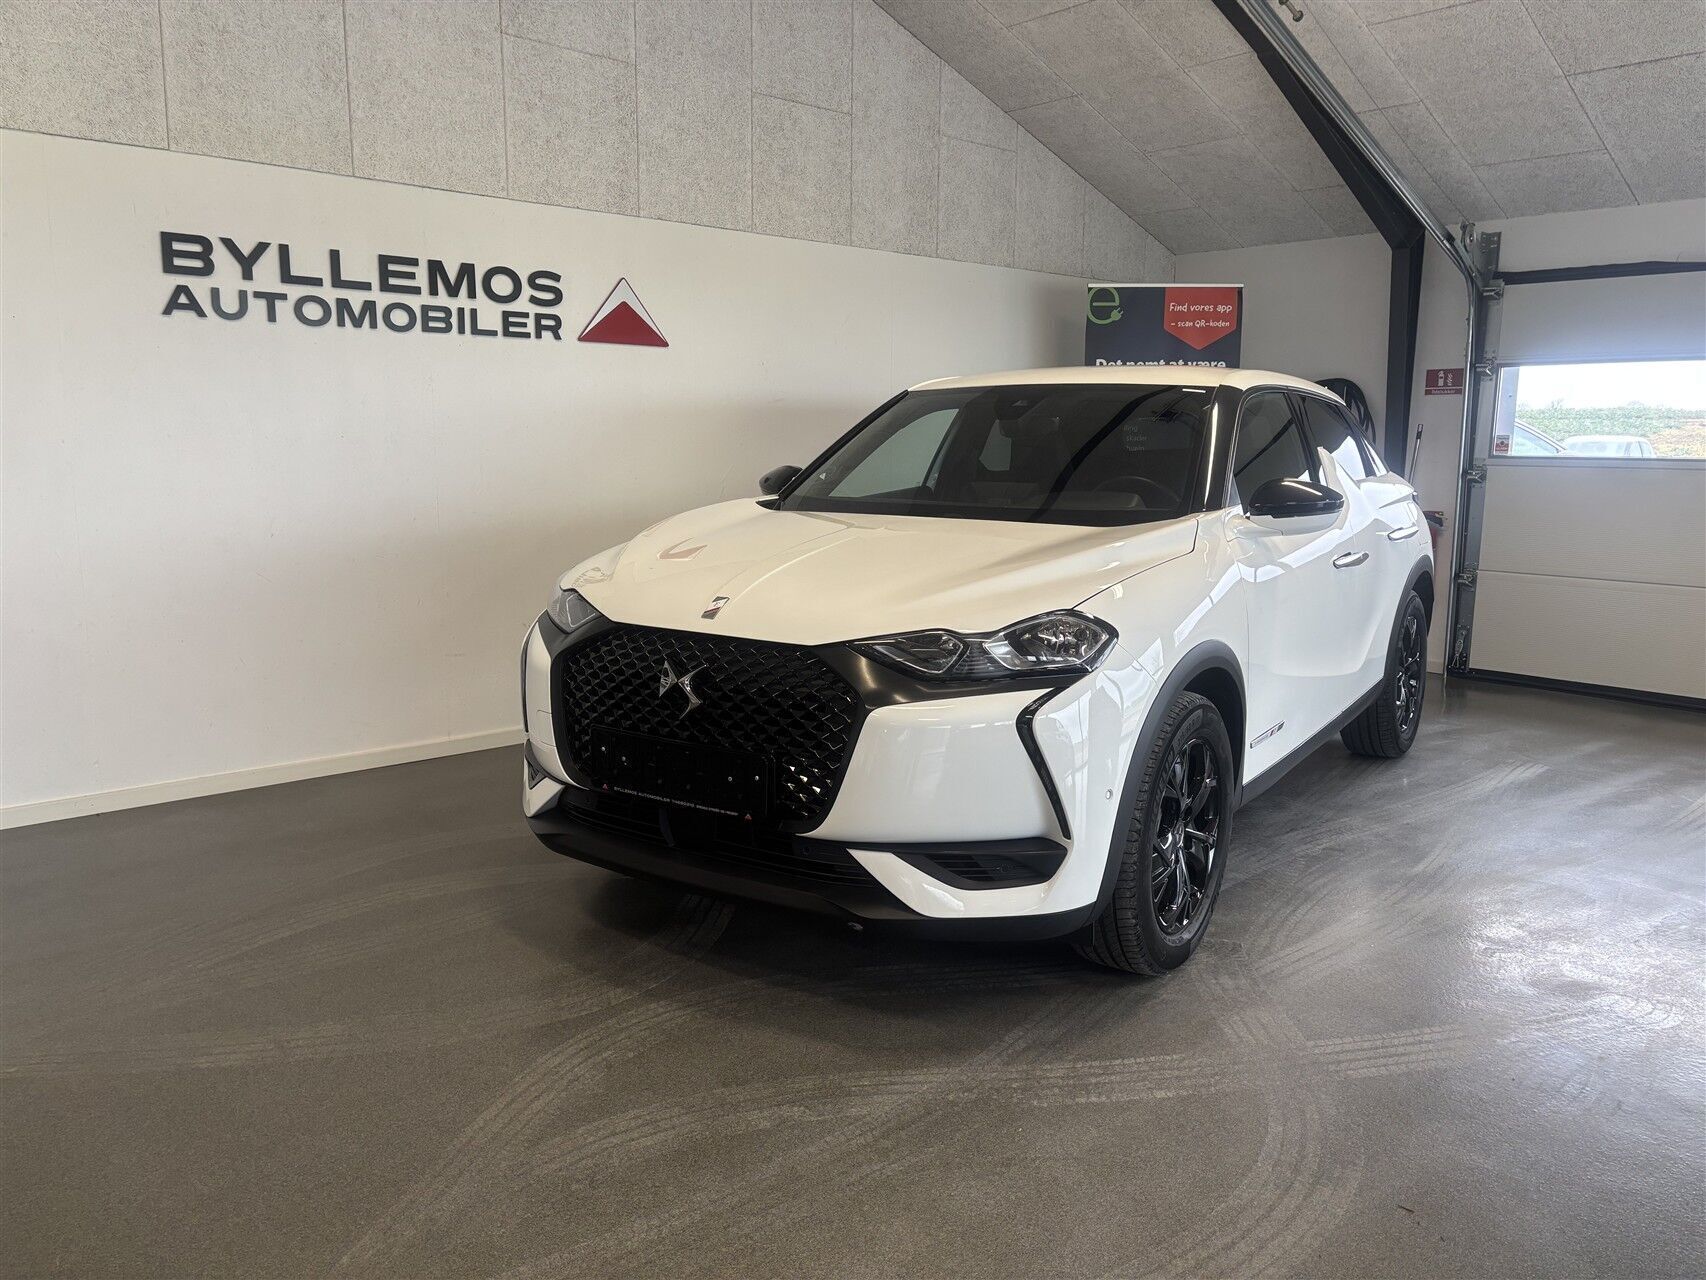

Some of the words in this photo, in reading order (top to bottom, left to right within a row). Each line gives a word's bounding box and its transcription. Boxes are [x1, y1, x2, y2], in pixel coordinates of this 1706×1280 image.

[160, 231, 564, 308] BYLLEMOS
[161, 283, 563, 341] AUTOMOBILER
[1169, 302, 1188, 312] Find
[1190, 304, 1214, 312] vores
[1216, 304, 1233, 314] app
[1194, 319, 1230, 329] QR-koden
